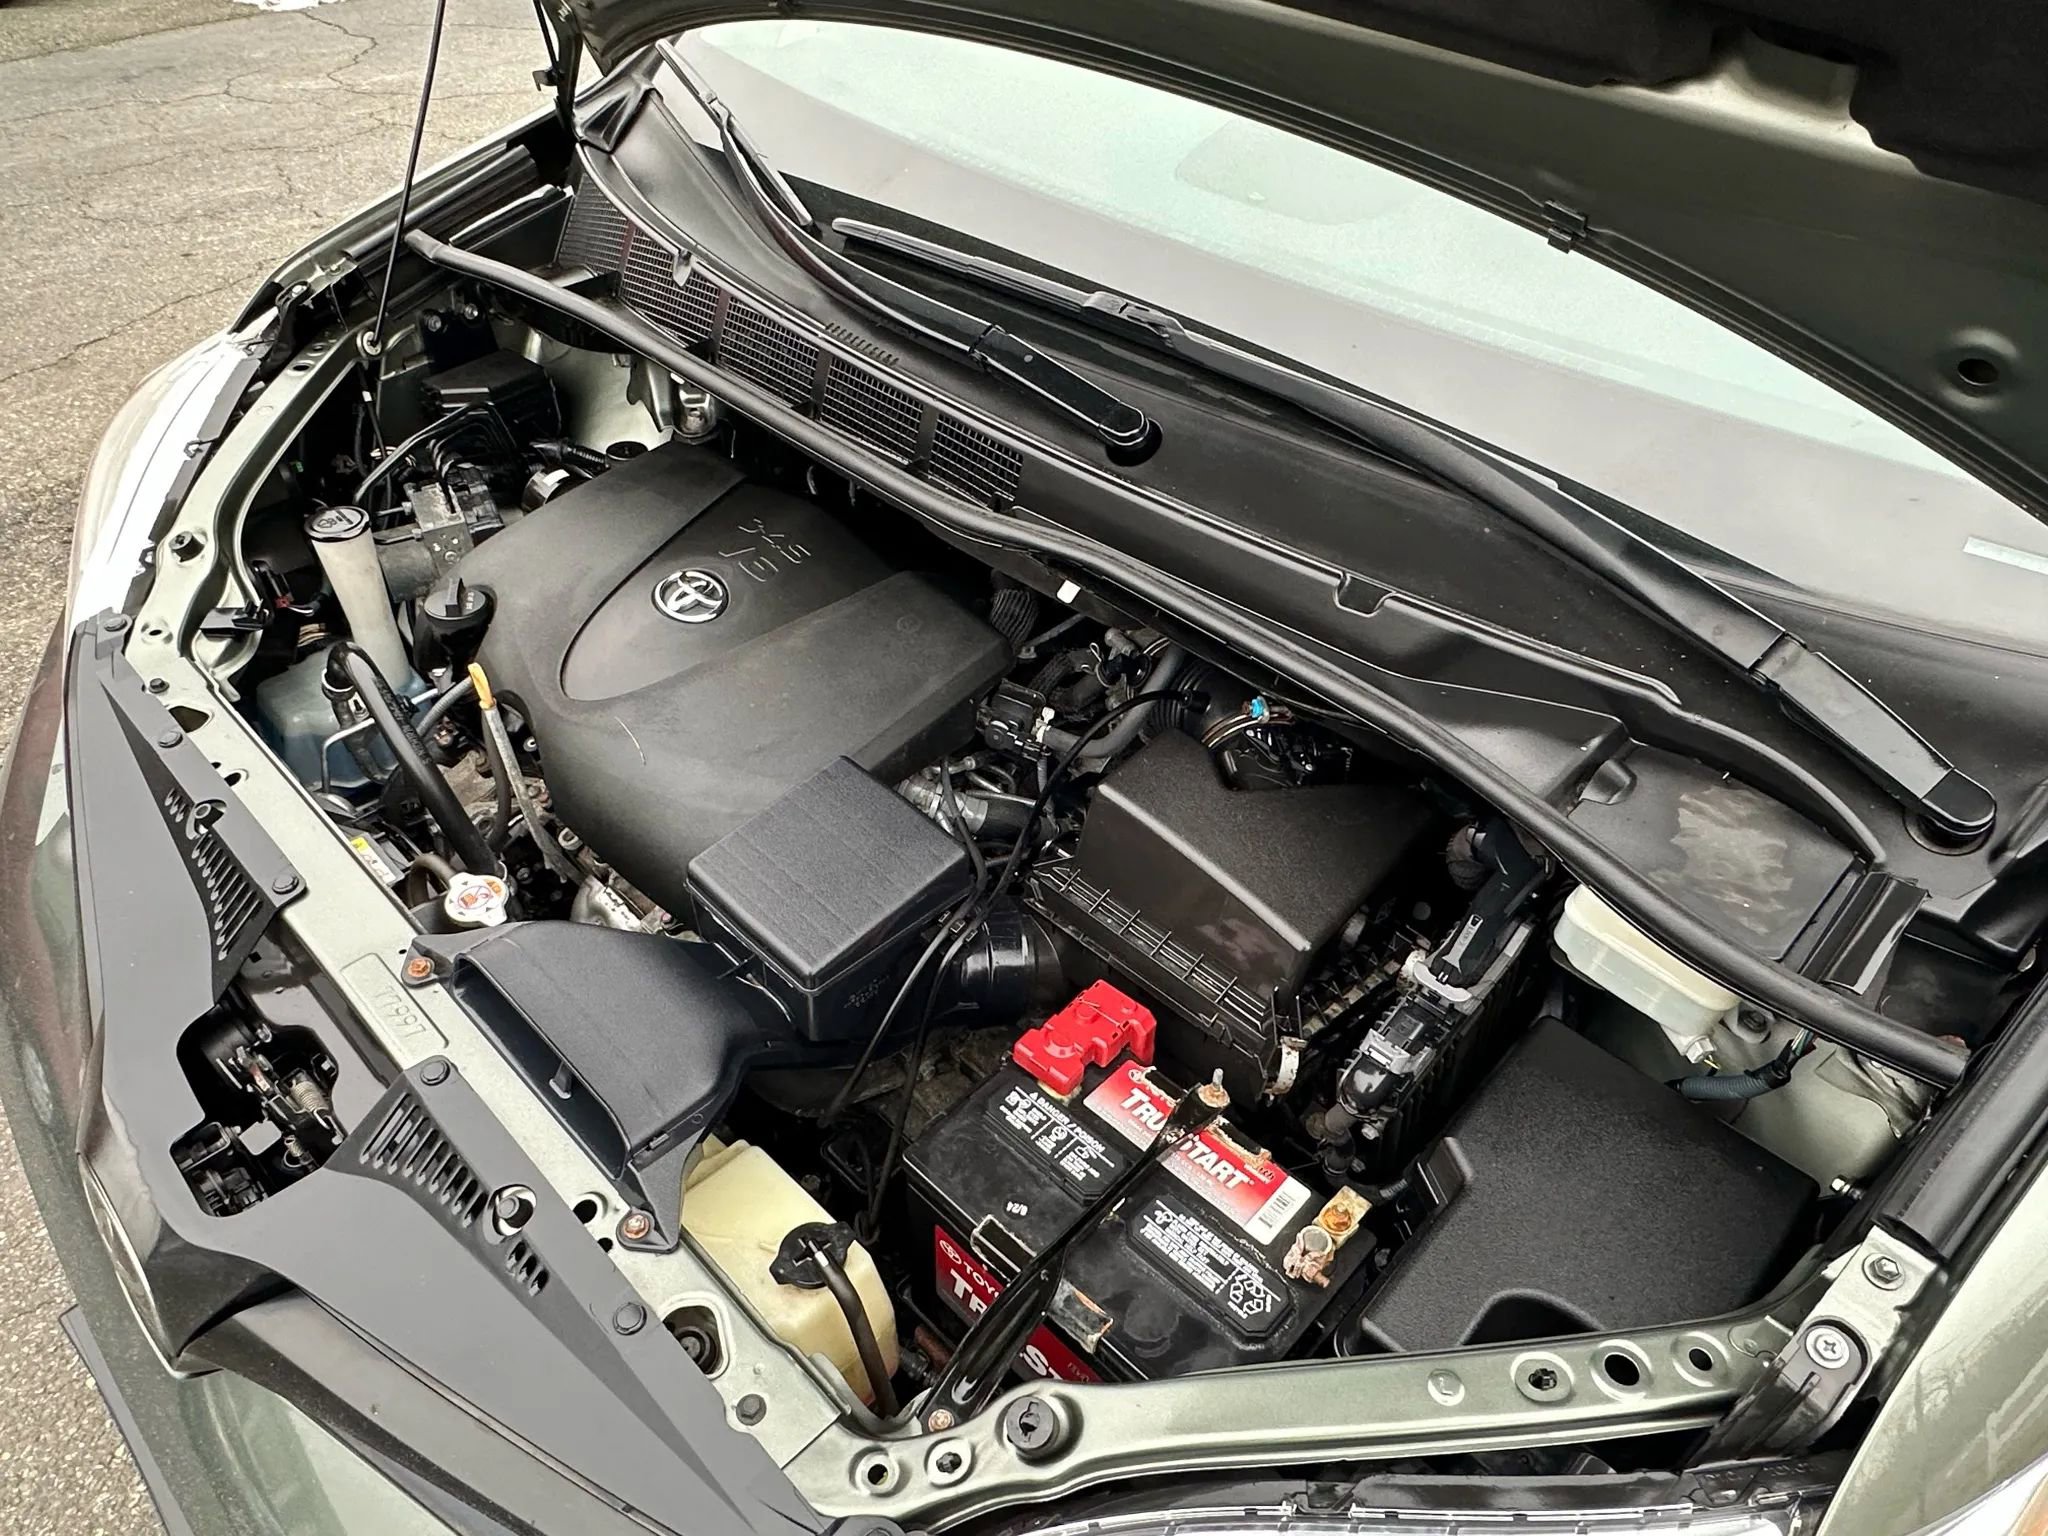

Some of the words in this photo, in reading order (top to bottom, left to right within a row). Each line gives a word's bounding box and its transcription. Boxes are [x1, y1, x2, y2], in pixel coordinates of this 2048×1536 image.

[1036, 1096, 1071, 1124] DANGER
[1073, 1126, 1106, 1153] POISON
[963, 1260, 999, 1298] TOY
